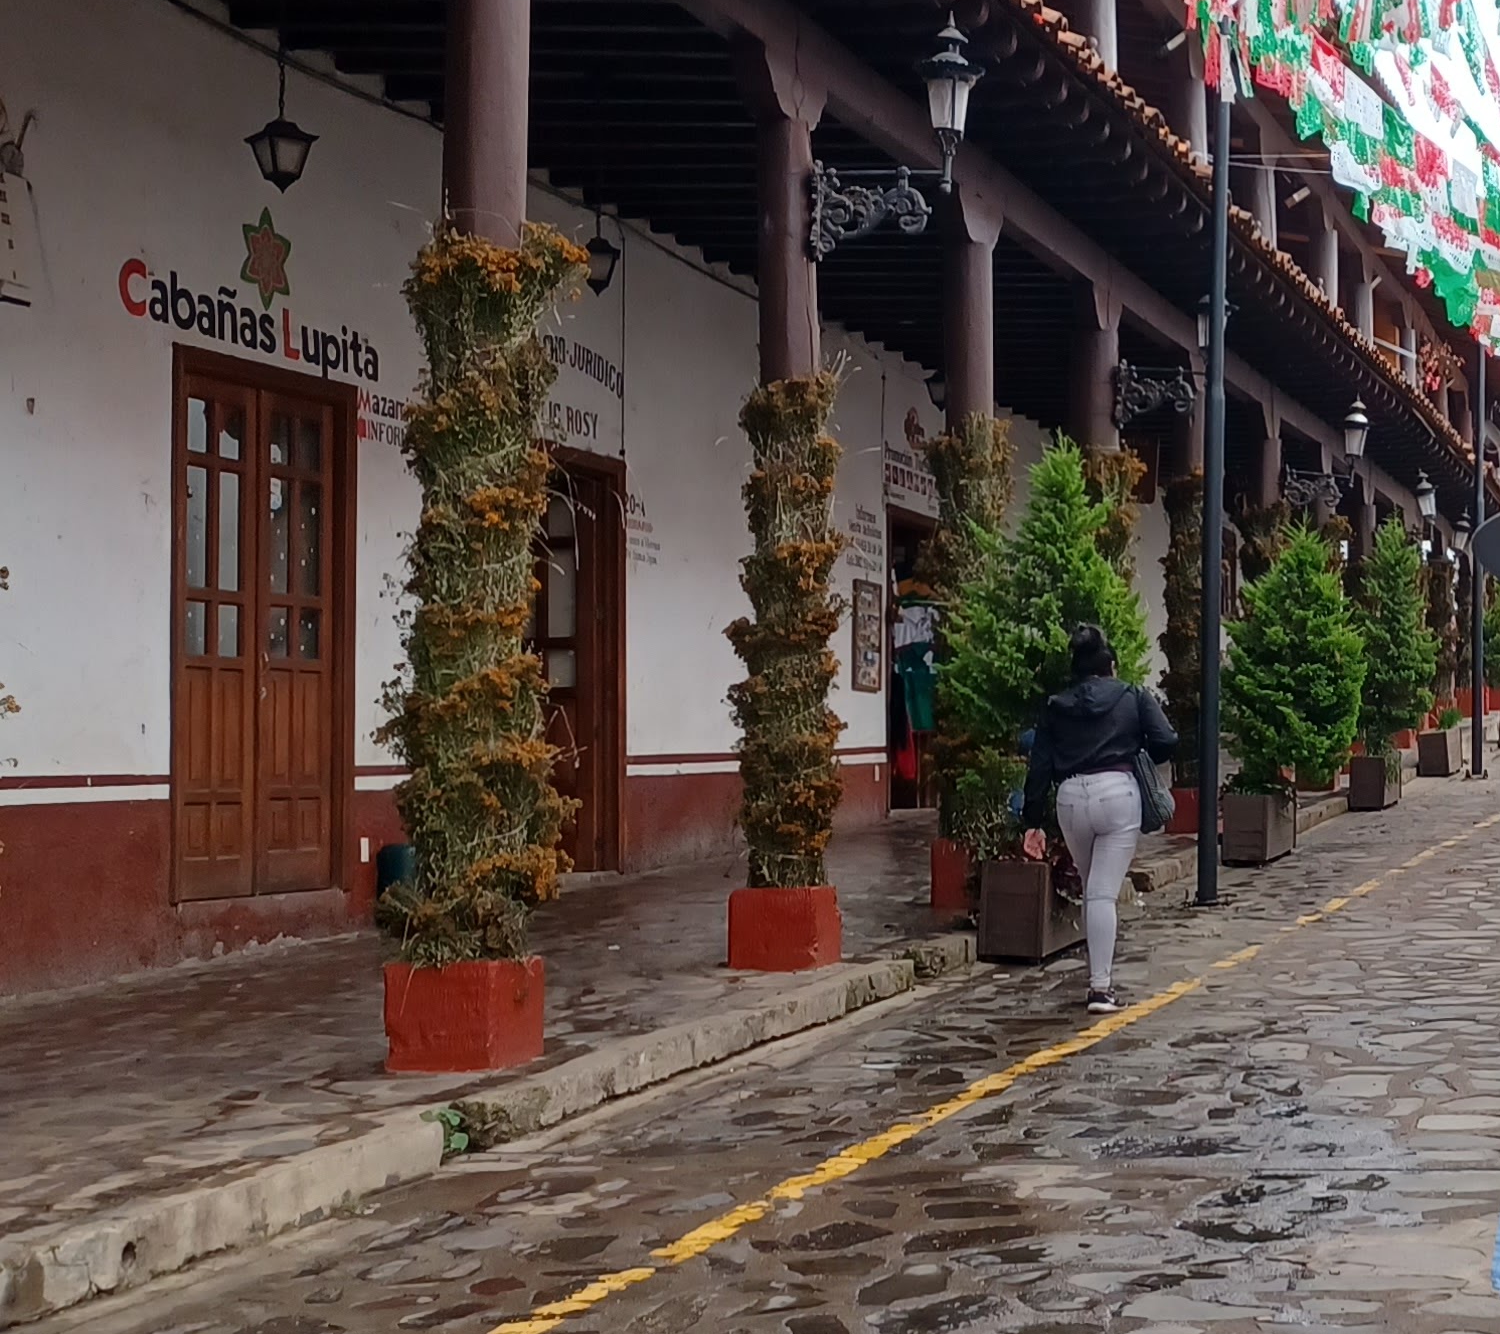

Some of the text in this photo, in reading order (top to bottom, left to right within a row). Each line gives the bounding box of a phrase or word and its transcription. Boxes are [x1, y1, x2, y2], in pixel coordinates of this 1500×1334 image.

[118, 258, 379, 382] Cabañas Lupita
[566, 405, 598, 440] ROSY
